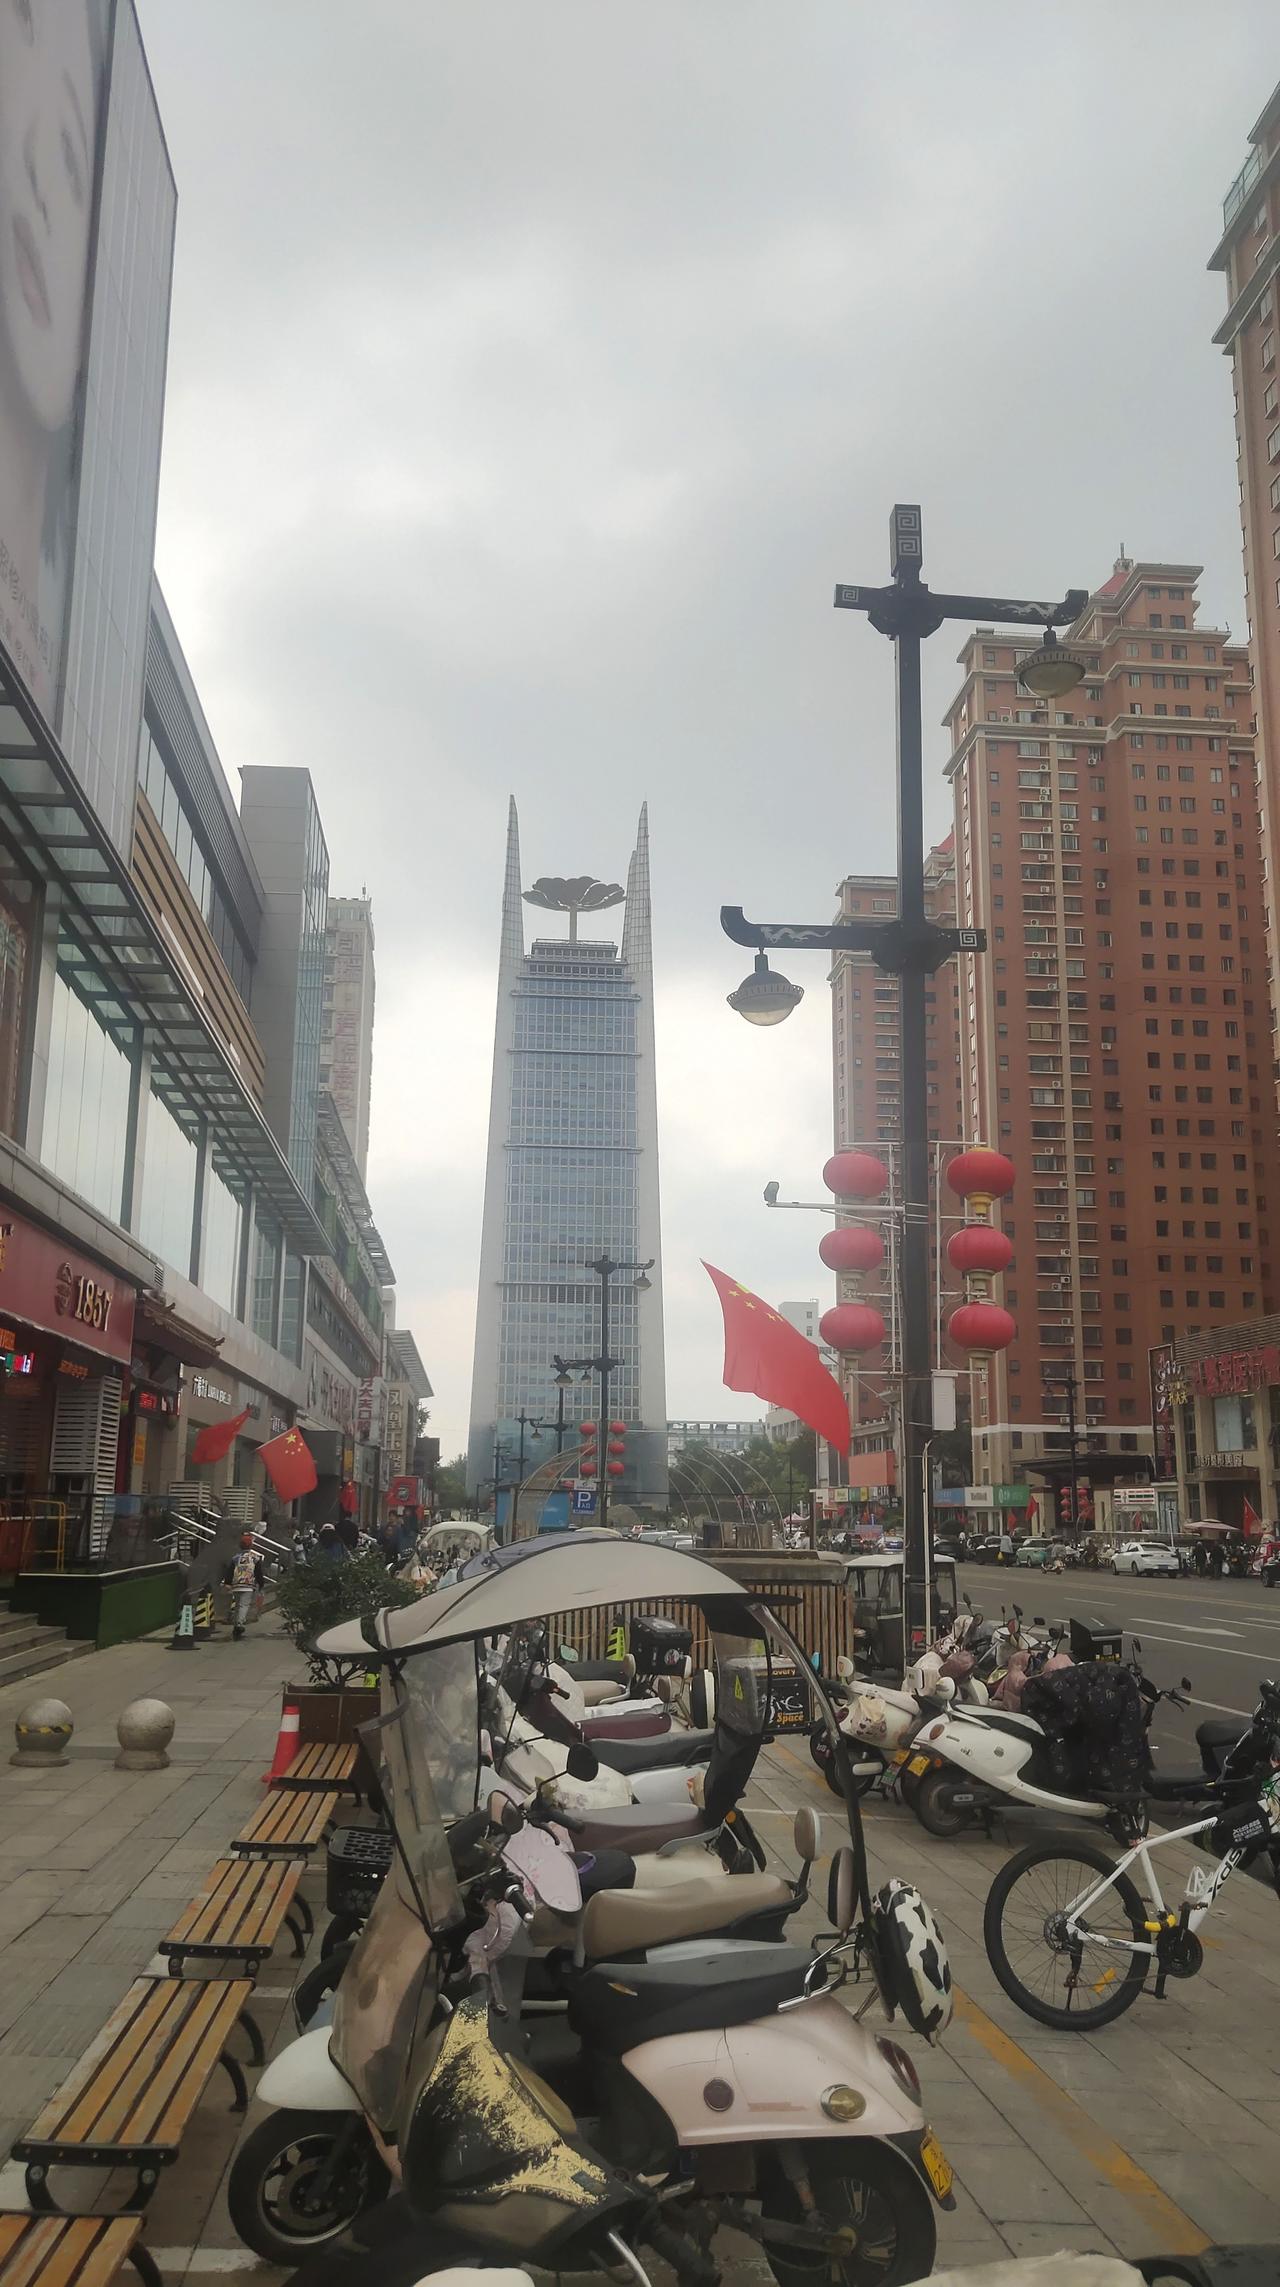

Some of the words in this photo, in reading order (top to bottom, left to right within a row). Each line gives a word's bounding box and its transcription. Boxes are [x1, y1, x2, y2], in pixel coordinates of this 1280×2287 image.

[74, 1276, 114, 1332] 1857
[577, 1492, 591, 1508] P
[776, 1712, 805, 1724] Space
